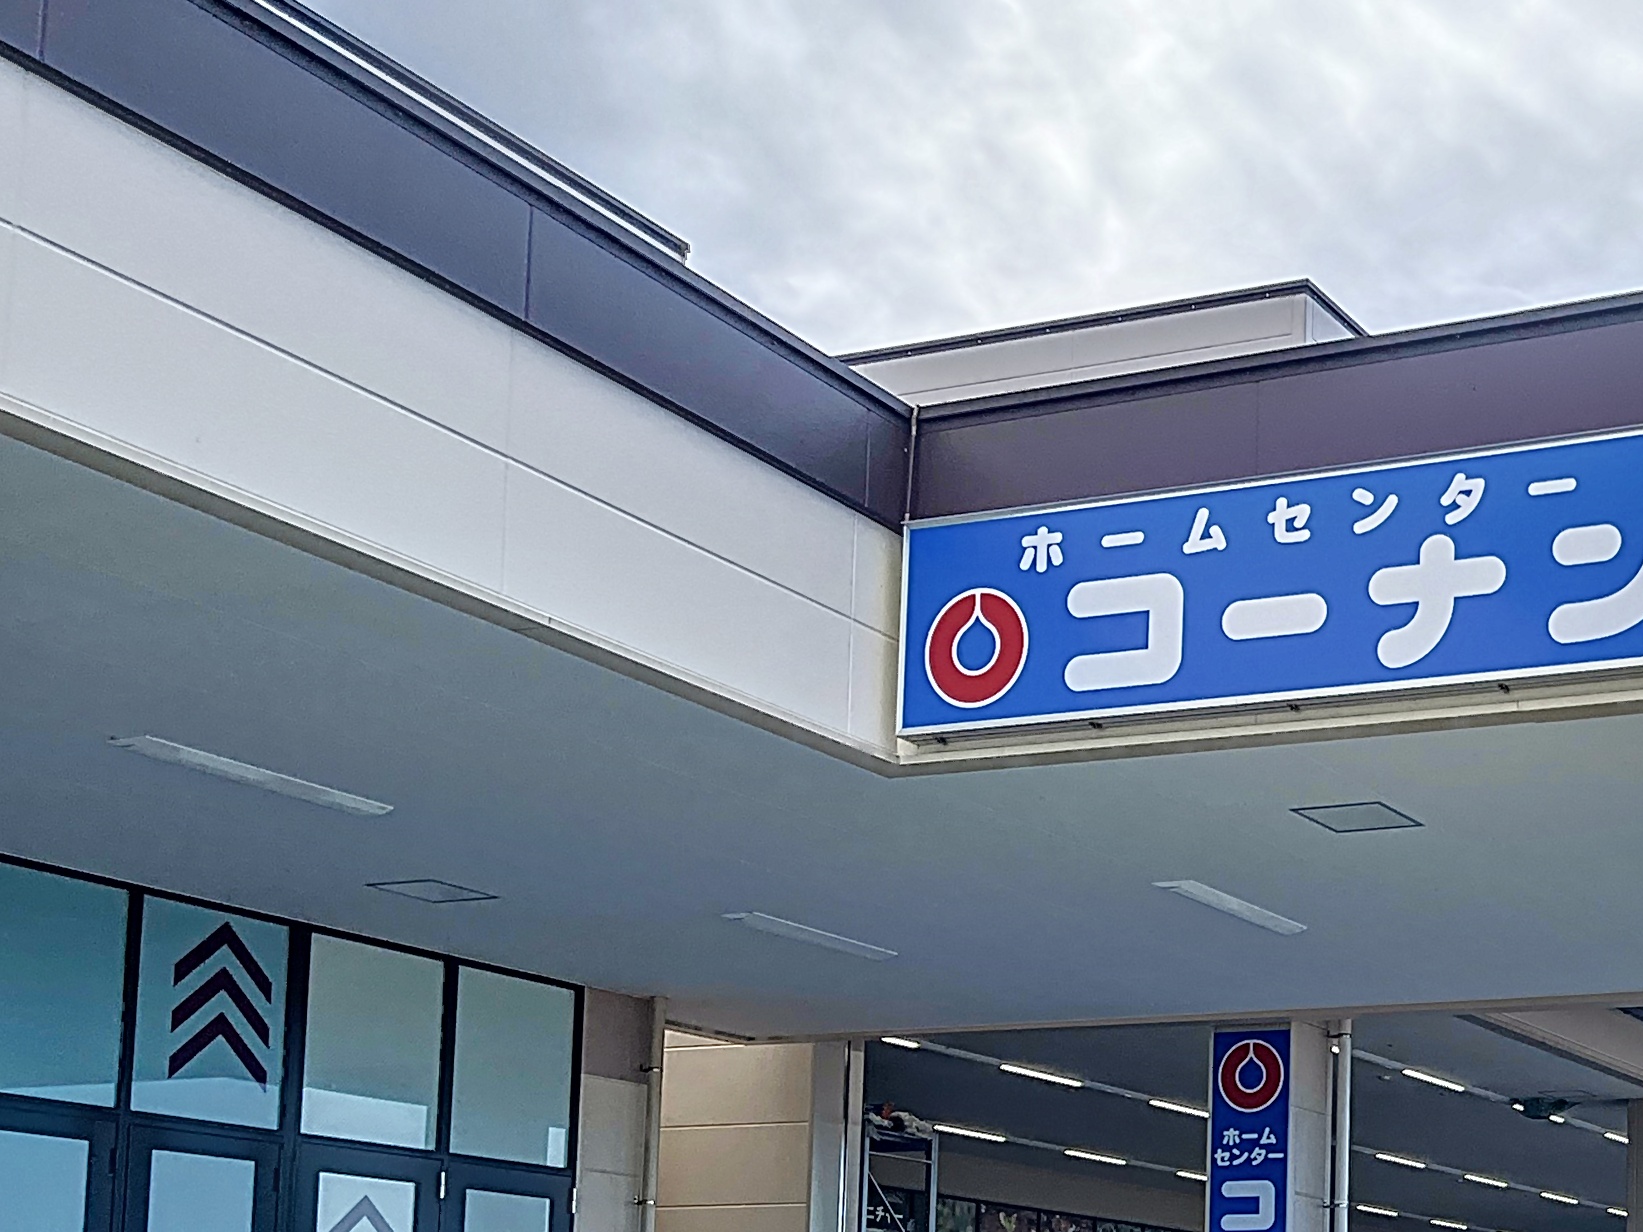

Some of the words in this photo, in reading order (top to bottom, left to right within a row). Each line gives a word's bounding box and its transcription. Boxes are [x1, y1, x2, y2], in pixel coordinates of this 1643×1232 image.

[1019, 472, 1578, 574] ホームセンター
[1222, 1127, 1277, 1146] ホーム
[1214, 1147, 1285, 1166] センター
